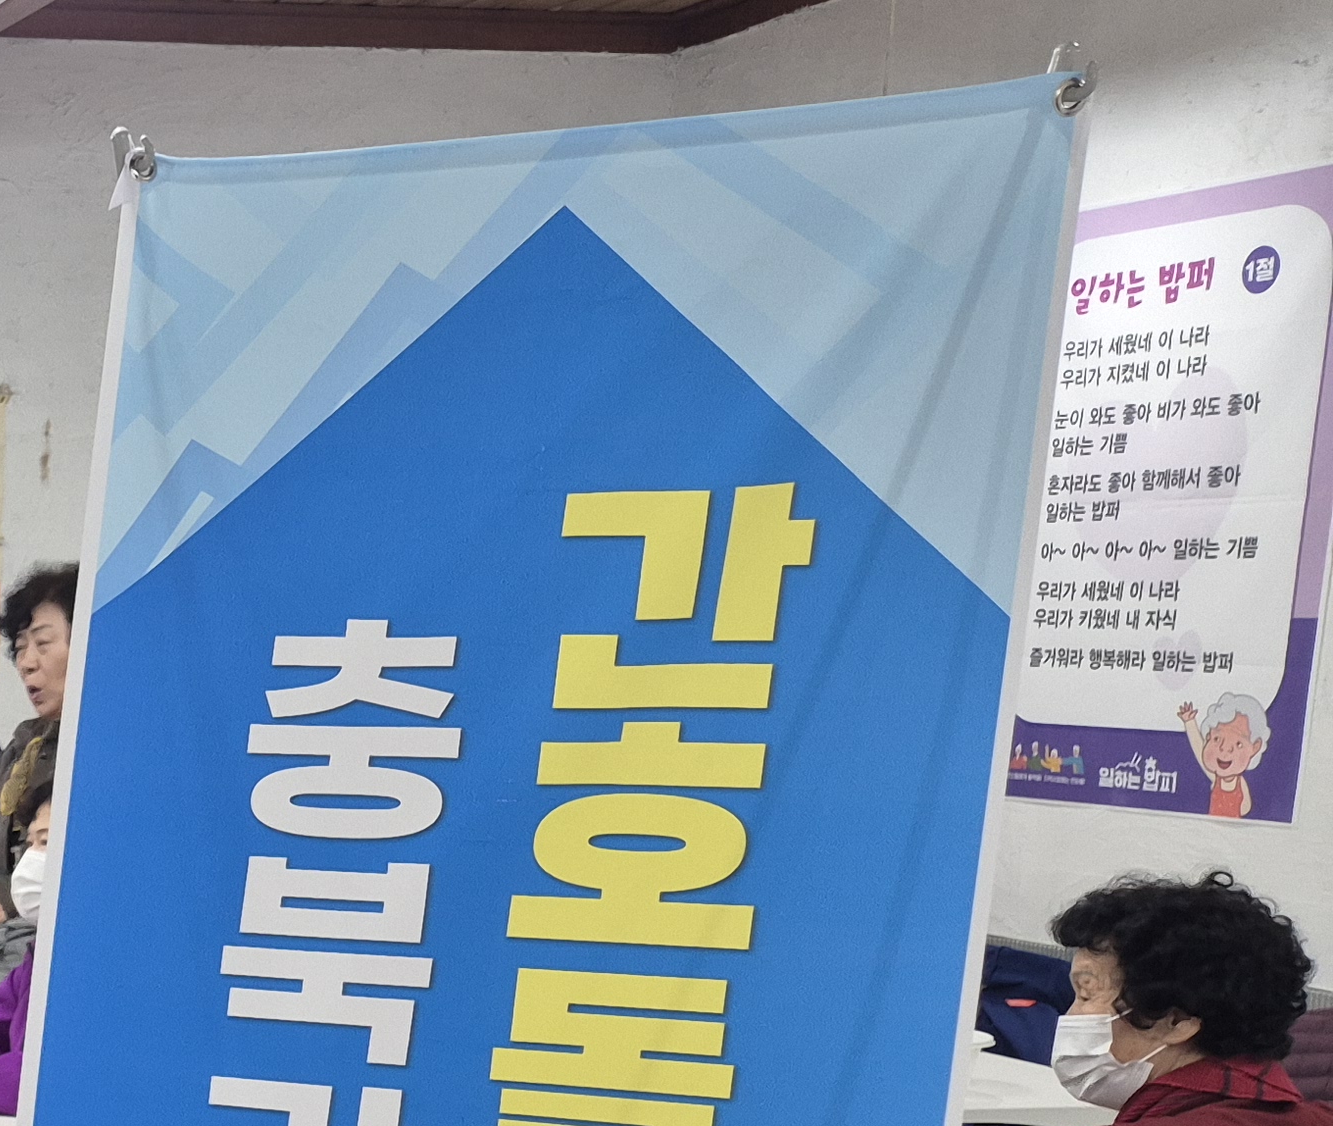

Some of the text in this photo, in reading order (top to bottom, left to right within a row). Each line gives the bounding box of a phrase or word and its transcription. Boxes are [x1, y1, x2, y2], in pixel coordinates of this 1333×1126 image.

[1246, 256, 1275, 282] 1절
[1071, 257, 1215, 315] 일하는 밥퍼
[1063, 324, 1210, 361] 우리가 세웠네 이 나라
[1060, 354, 1207, 389] 우리가 지켰네 이 나라
[1054, 391, 1261, 429] 눈이 와도 좋아 비가 와도 좋아
[1052, 432, 1127, 457] 일하는 기쁨
[1048, 464, 1241, 495] 혼자라도 좋아 함께해서 좋아
[1046, 500, 1120, 523] 일하는 밥퍼
[1041, 536, 1258, 562] 아~ 아~ 아~ 아~ 일하는 기쁨
[1036, 580, 1180, 602] 우리가 세웠네 이 나라
[1033, 608, 1177, 630] 우리가 키웠네 내 자식
[1029, 647, 1234, 674] 즐거워라 행복해라 일하는 밥퍼
